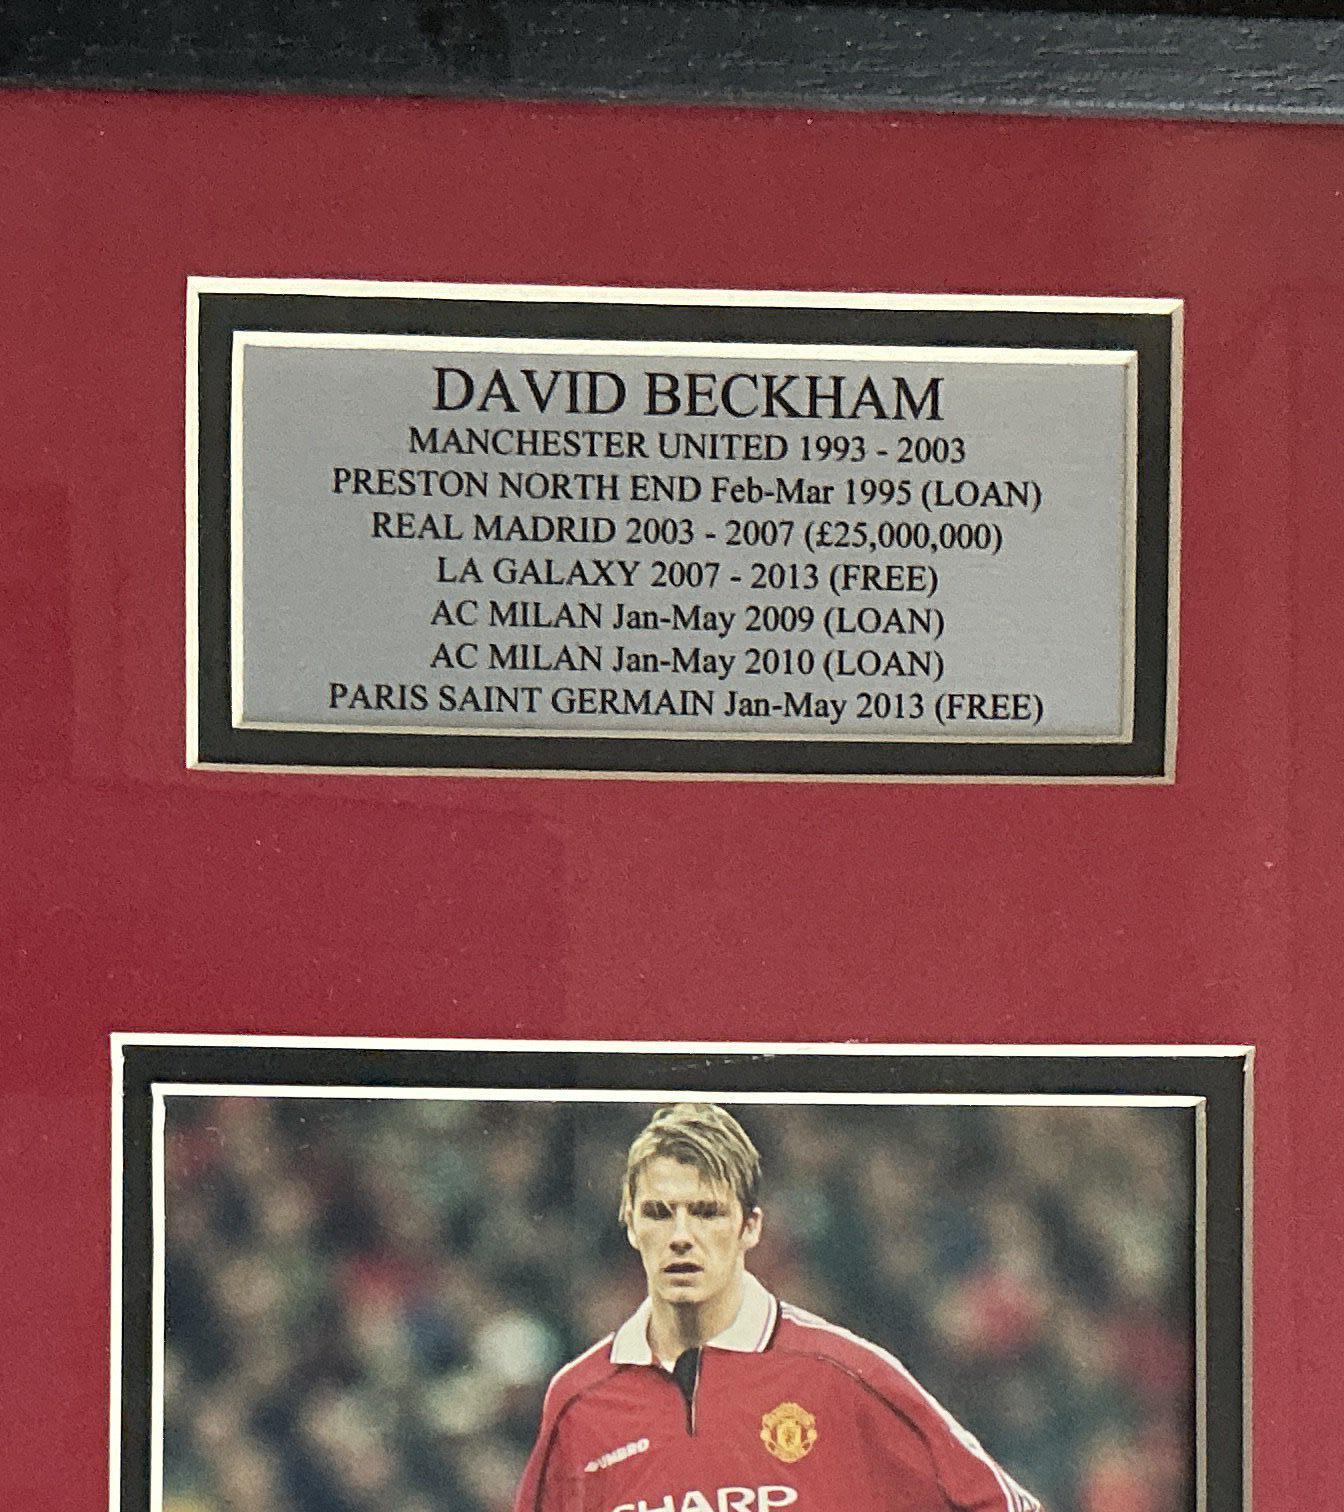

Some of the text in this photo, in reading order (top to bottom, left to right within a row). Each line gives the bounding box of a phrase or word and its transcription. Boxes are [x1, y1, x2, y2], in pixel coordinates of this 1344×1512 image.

[432, 366, 945, 421] DAVID BECKHAM
[409, 426, 649, 459] MANCHESTER
[659, 431, 789, 461] UNITED
[800, 435, 865, 463] 1993
[896, 437, 966, 464] 2003
[332, 467, 1042, 512] PRESTON NORTH END Feb-Mar 1995 (LOAN)
[371, 511, 464, 540] REAL
[473, 513, 617, 544] MADRID
[626, 517, 694, 545] 2003
[724, 519, 795, 547] 2007
[805, 521, 1004, 555] (£25,000,000)
[436, 556, 484, 584] LA
[492, 557, 641, 587] GALAXY
[650, 561, 720, 588] 2007
[750, 563, 820, 590] 2013
[829, 564, 939, 597] (FREE)
[430, 600, 945, 640] AC MILAN Jan-May 2009 (LOAN)
[429, 643, 944, 683] AC MILAN Jan-May 2010 (LOAN)
[329, 682, 1044, 727] PARIS SAINT GERMAIN Jan-May 2013 (FREE)
